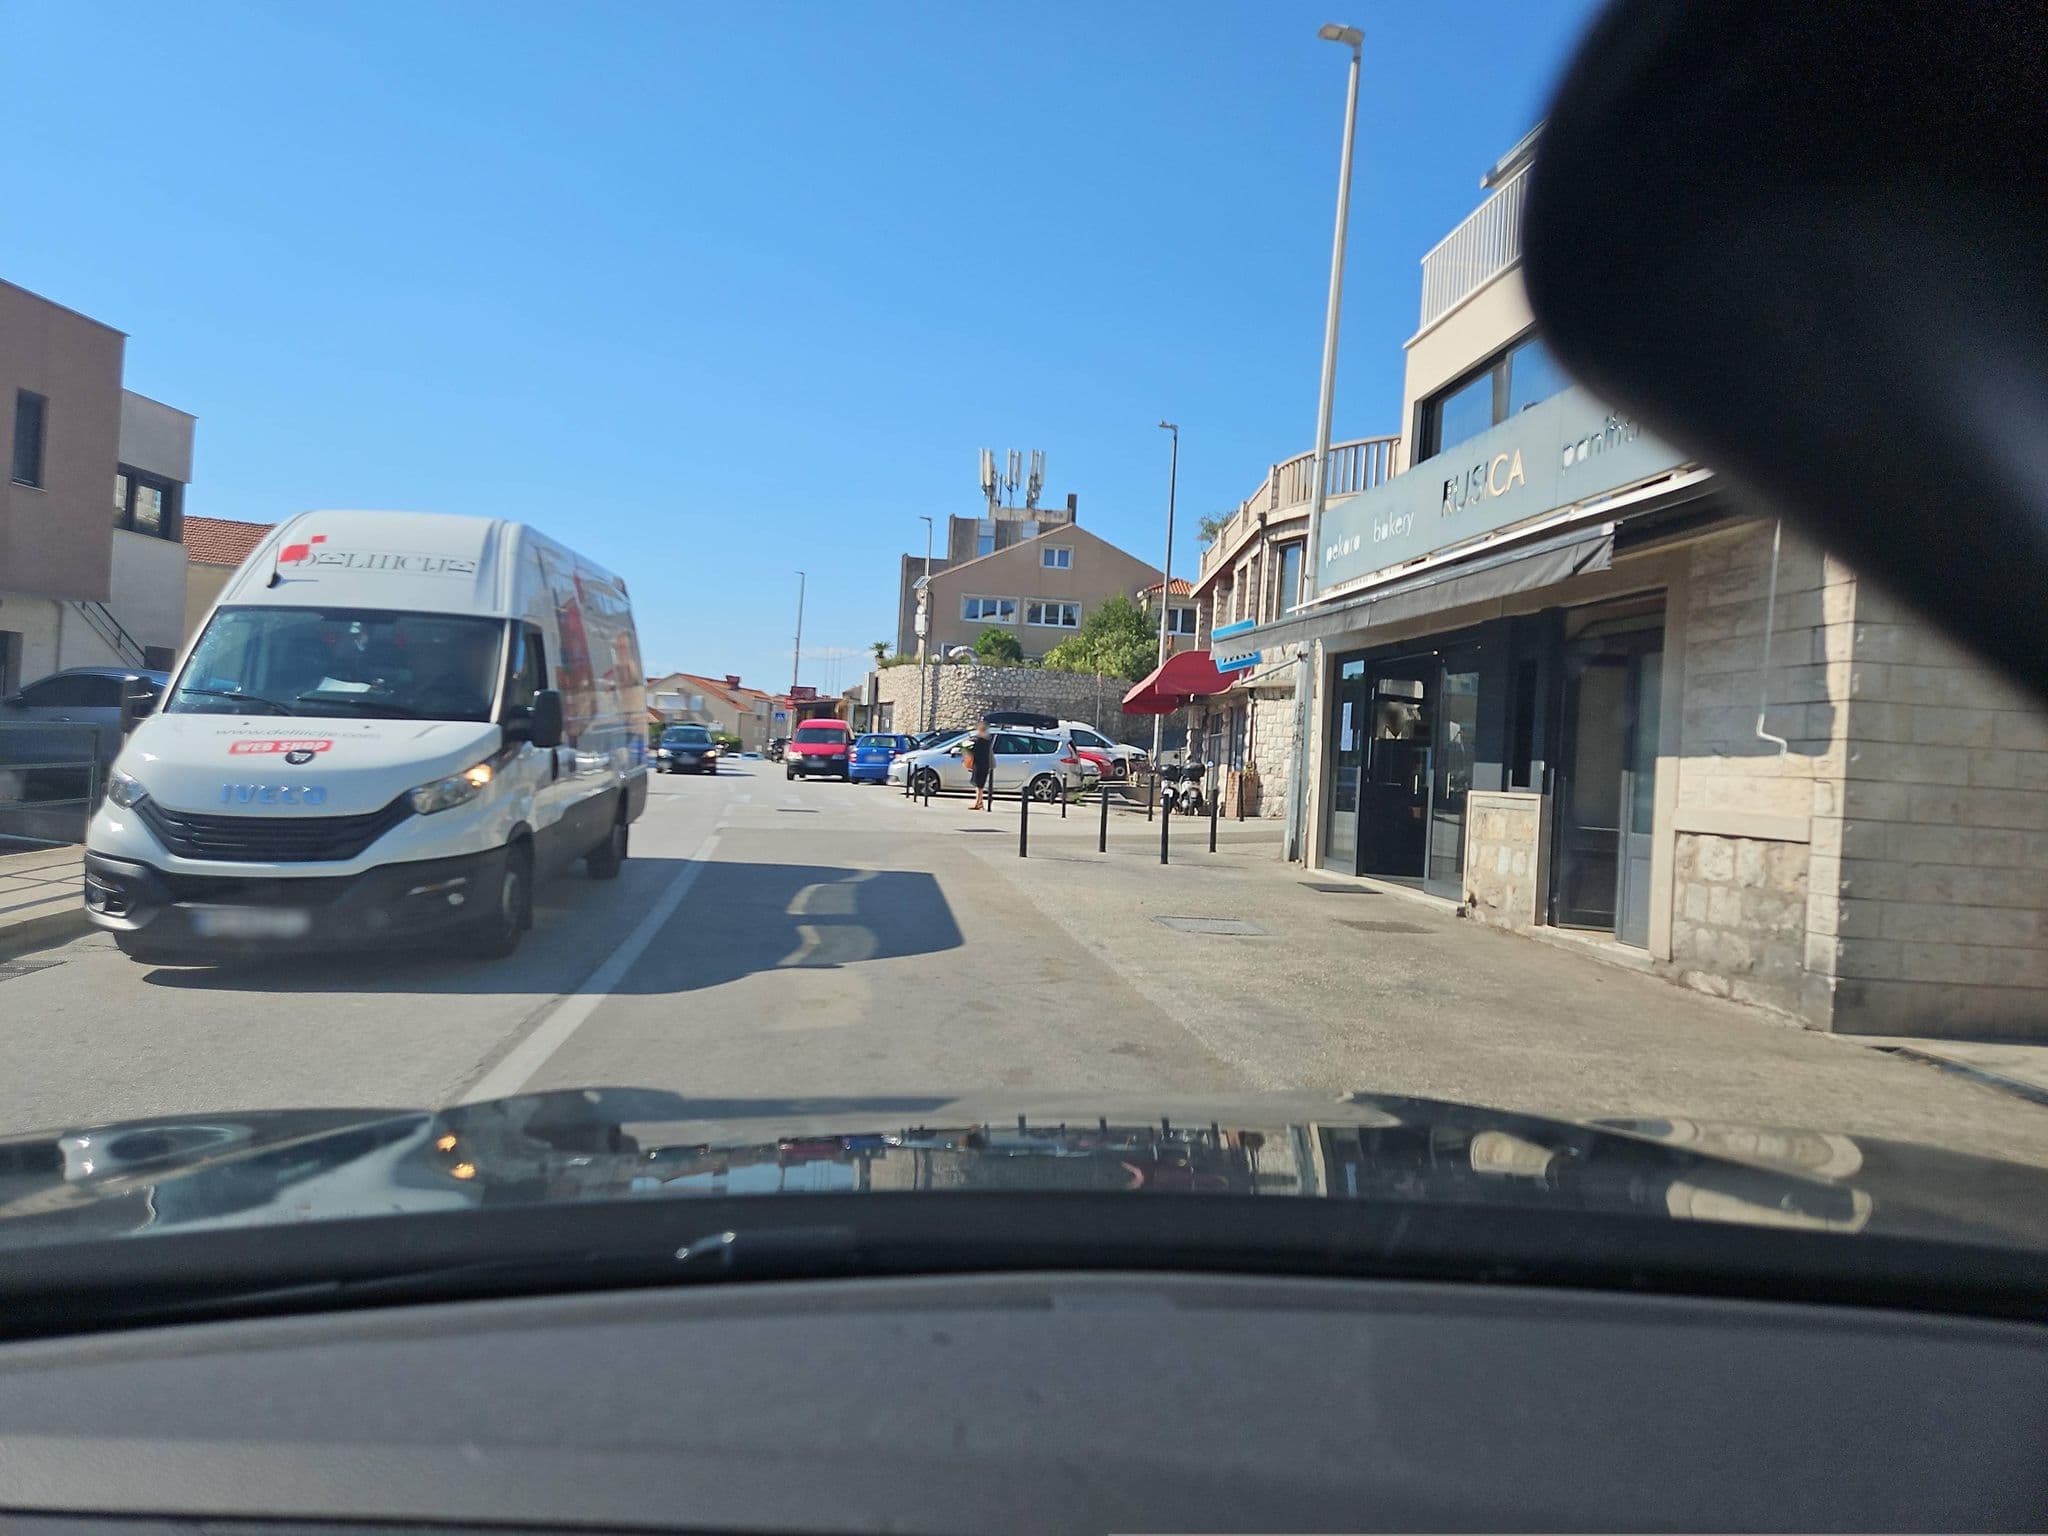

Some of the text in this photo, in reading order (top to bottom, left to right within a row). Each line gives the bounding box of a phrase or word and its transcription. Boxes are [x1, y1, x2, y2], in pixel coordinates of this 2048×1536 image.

[1325, 534, 1360, 568] pekara
[1373, 511, 1414, 543] bakery
[236, 740, 329, 752] WEB SHOP
[220, 783, 328, 805] IVECO
